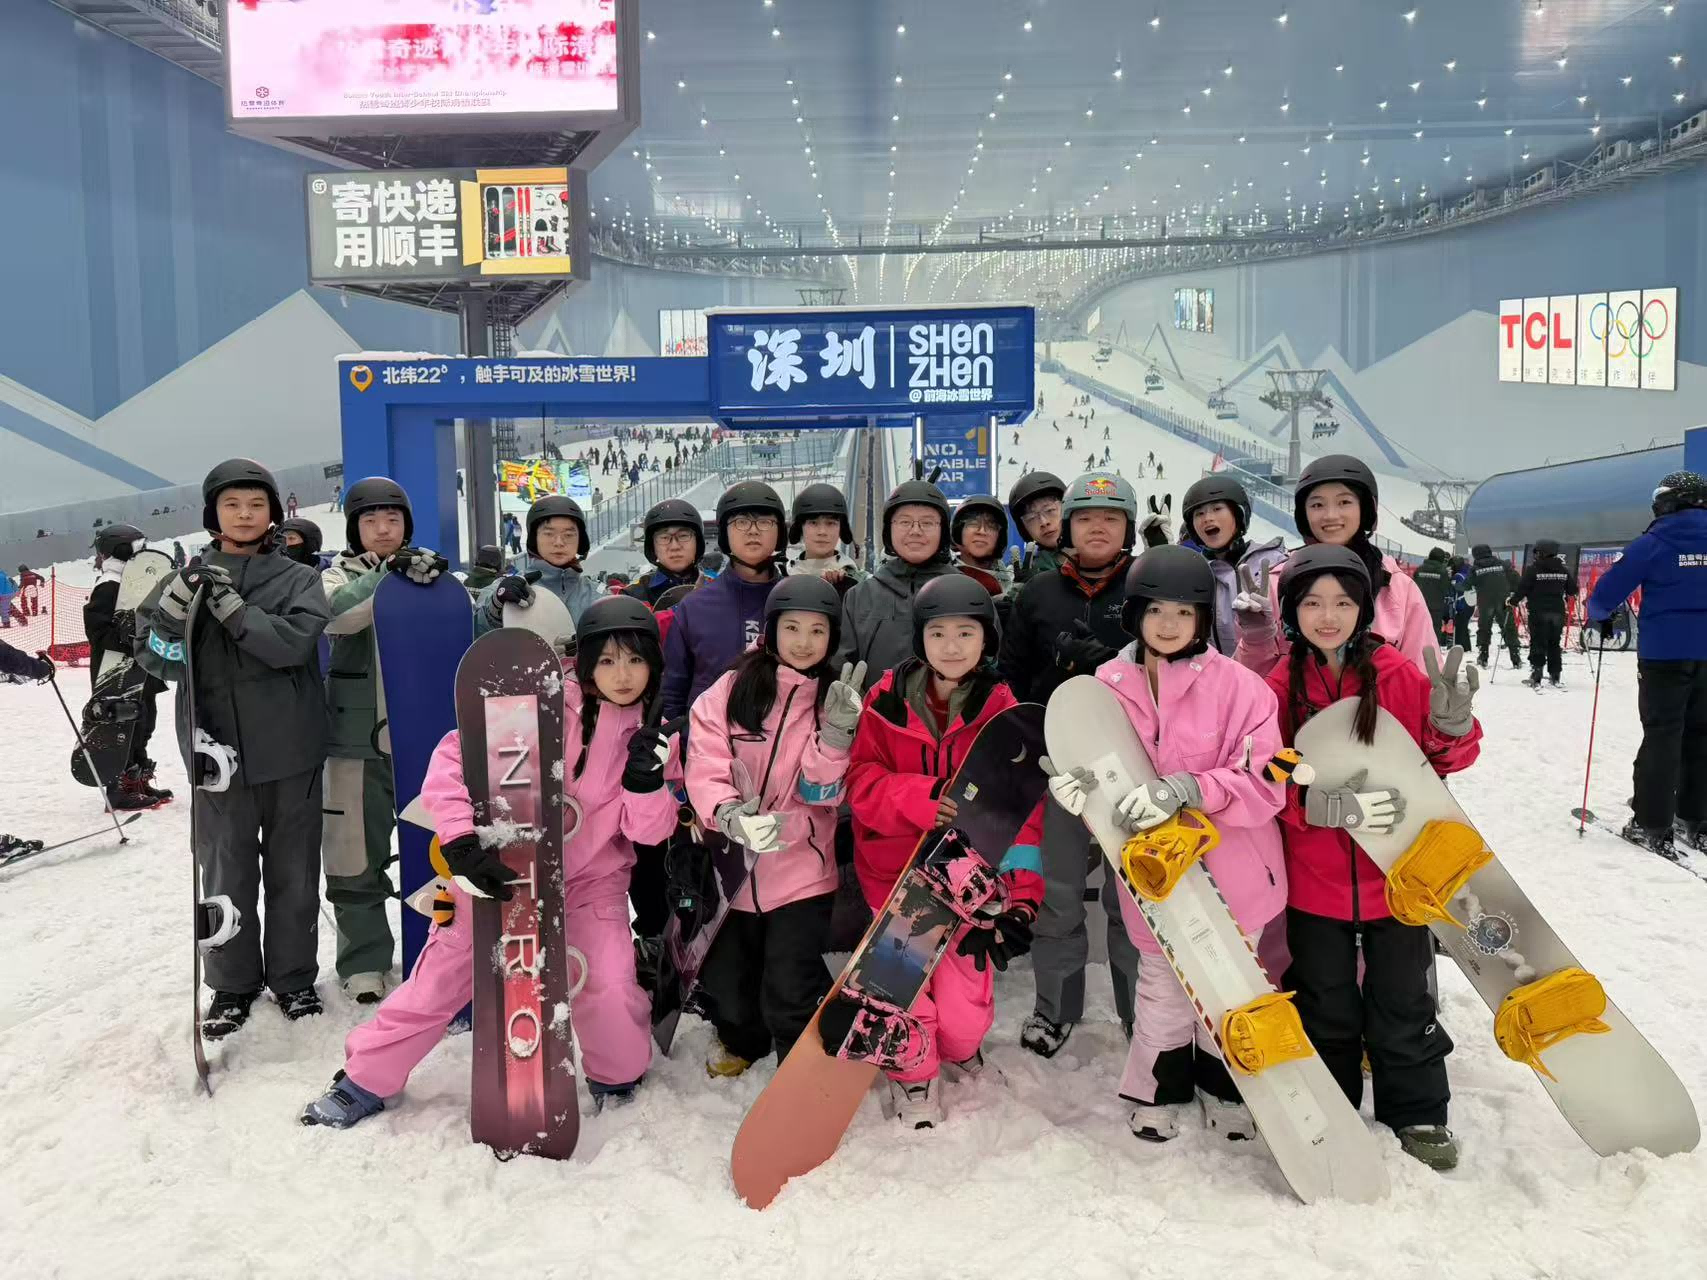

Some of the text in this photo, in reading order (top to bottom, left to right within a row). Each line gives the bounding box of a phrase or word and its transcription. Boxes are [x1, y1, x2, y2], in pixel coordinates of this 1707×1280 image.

[332, 178, 457, 224] 寄快递
[334, 223, 458, 268] 用顺丰
[1501, 312, 1572, 350] TCL
[748, 326, 876, 392] 深圳
[924, 458, 987, 469] CABLE
